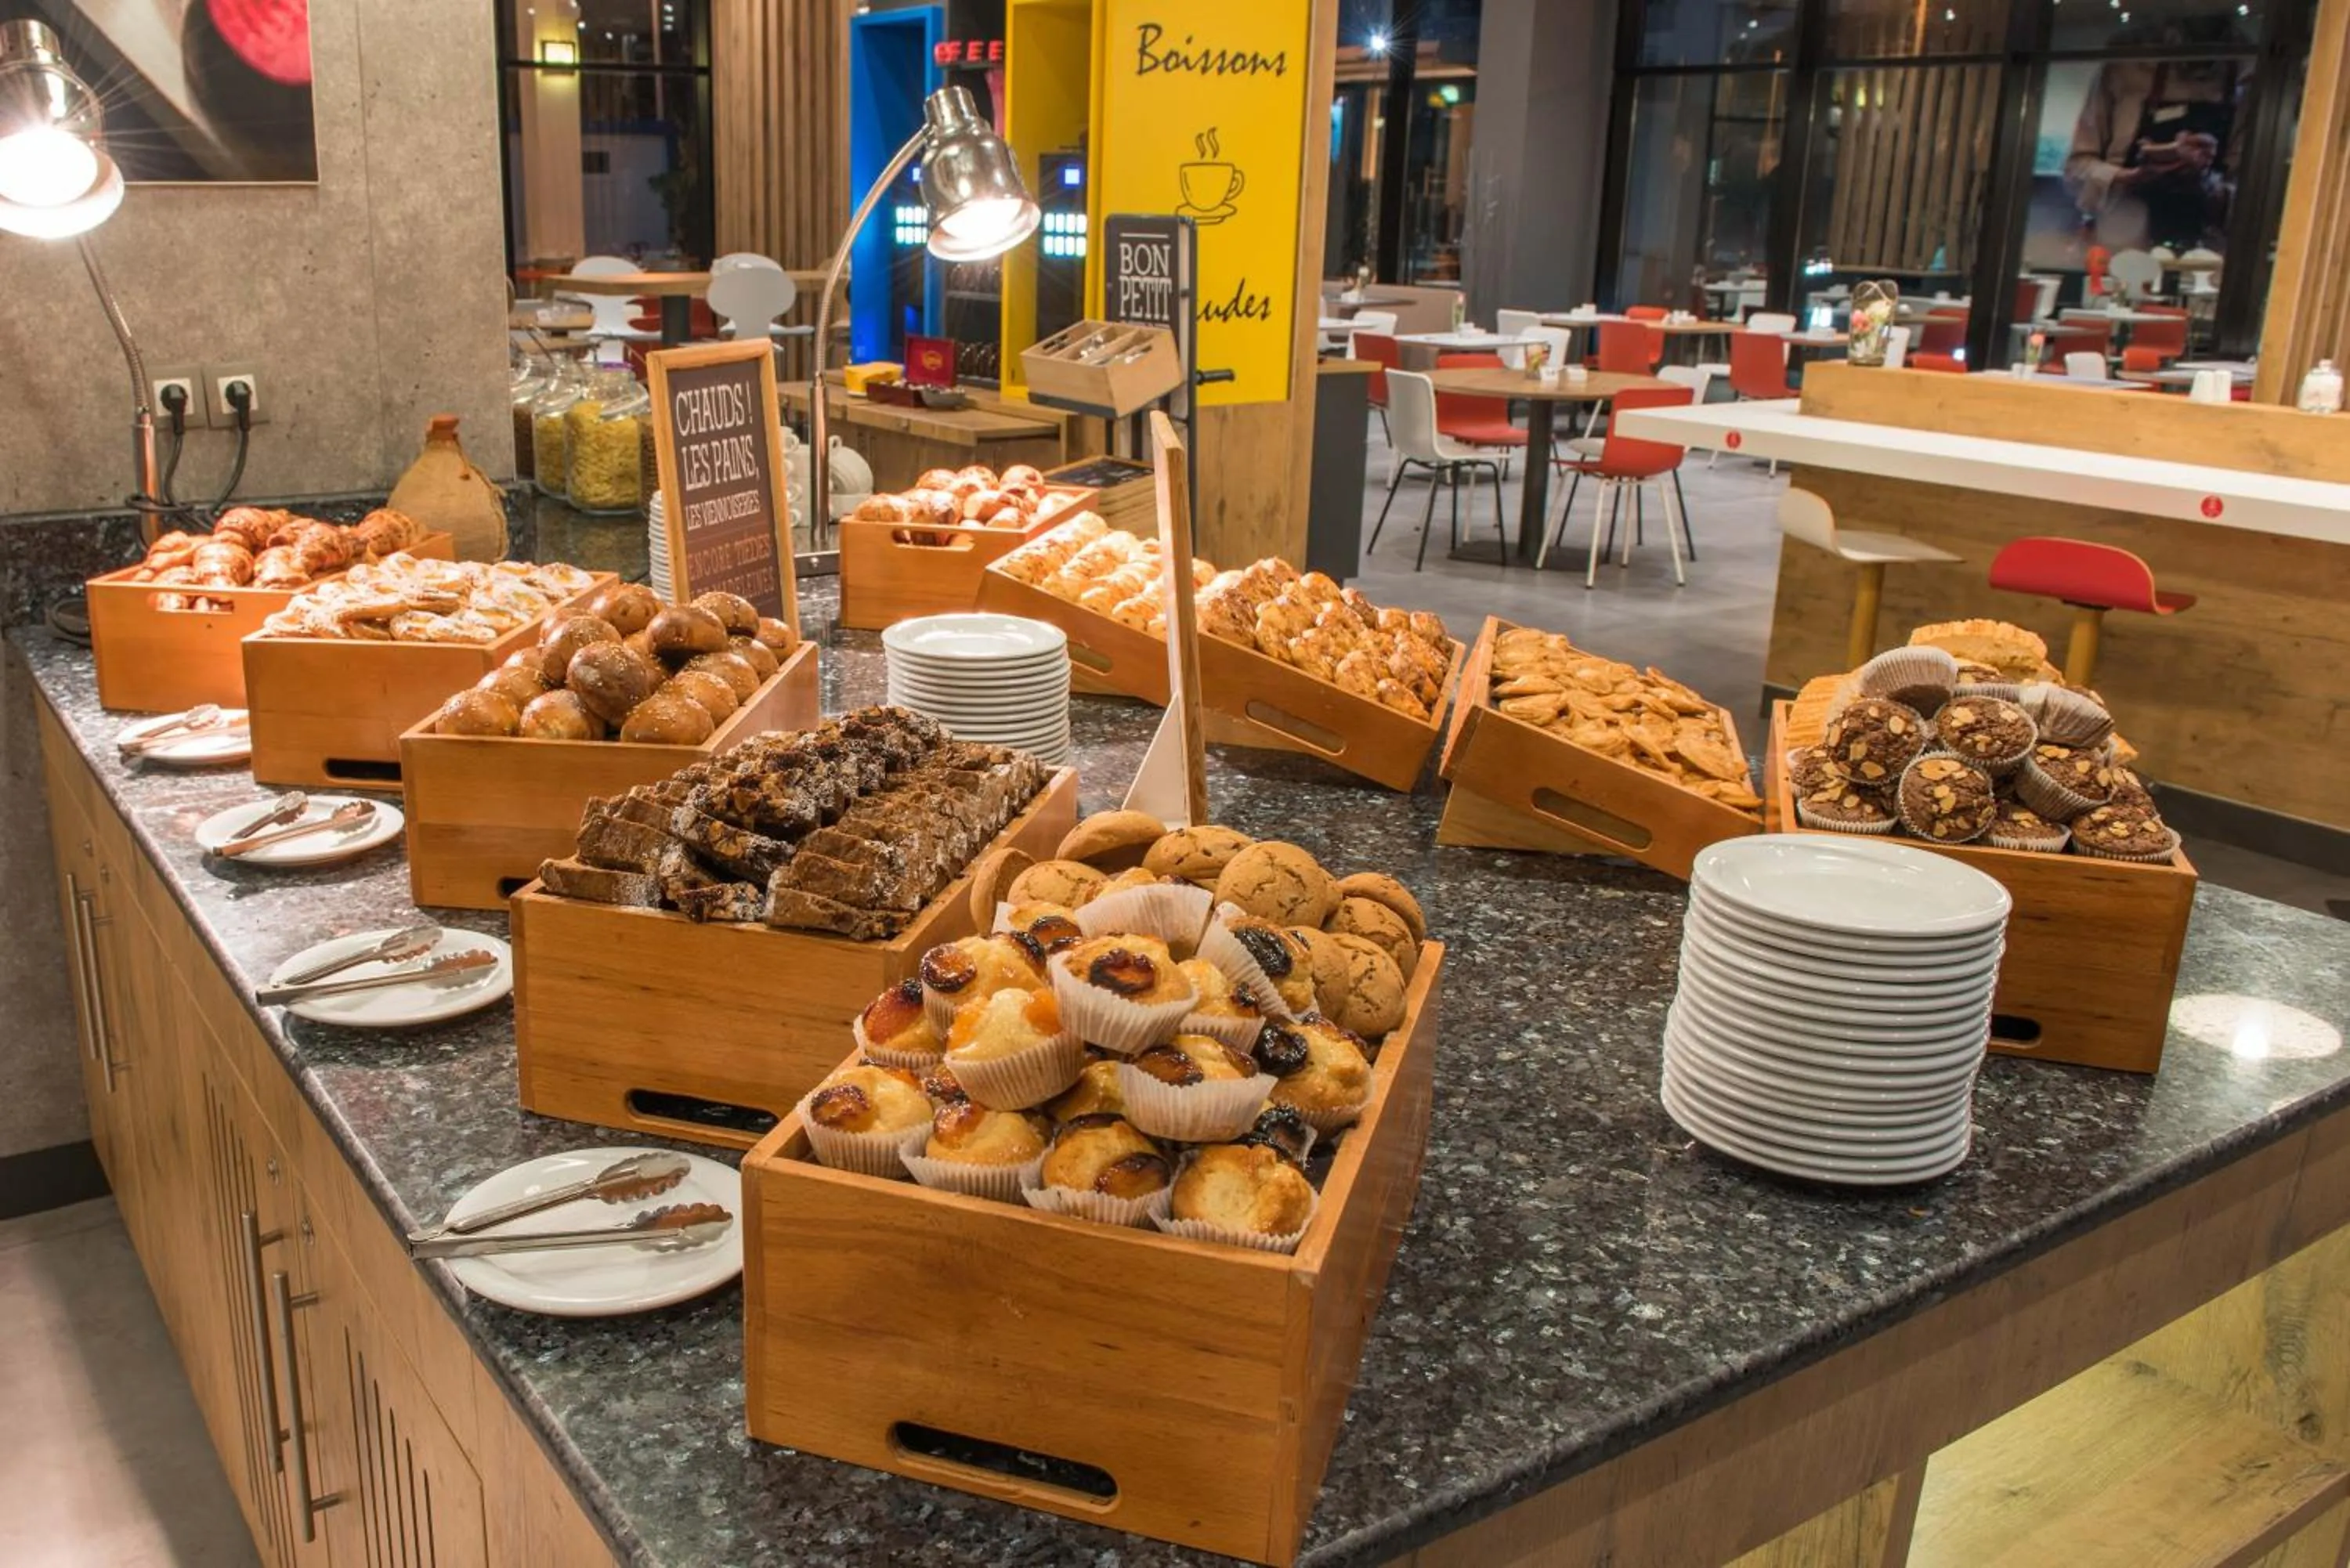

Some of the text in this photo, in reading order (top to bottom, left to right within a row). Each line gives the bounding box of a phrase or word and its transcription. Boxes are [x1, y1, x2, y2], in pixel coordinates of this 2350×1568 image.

[1136, 23, 1286, 77] Boissons
[1119, 243, 1170, 276] BON
[1119, 275, 1173, 321] PETIT
[1195, 277, 1271, 323] udes
[682, 434, 761, 491] LES PAINS,
[685, 502, 703, 530] LES
[688, 543, 732, 581] ENCORE
